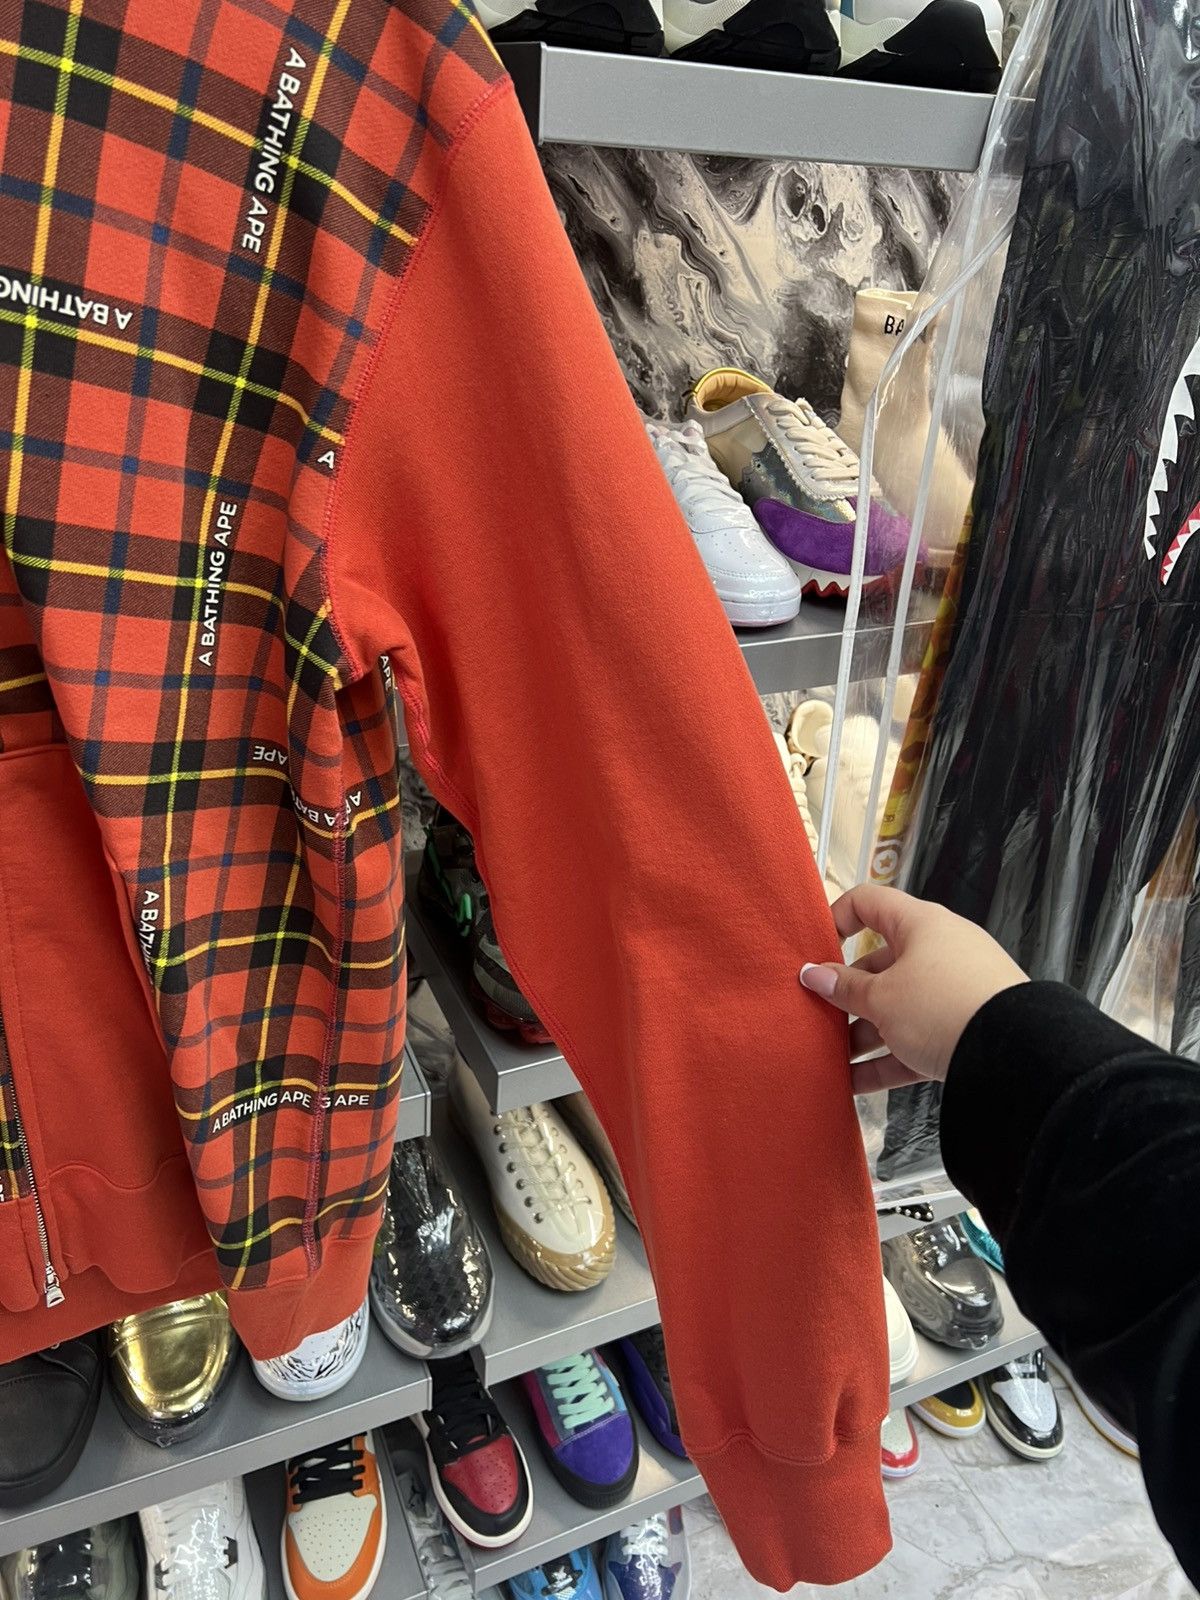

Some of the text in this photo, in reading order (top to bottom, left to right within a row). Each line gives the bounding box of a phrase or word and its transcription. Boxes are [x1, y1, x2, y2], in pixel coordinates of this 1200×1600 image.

[241, 47, 307, 253] A BATHING APE
[114, 307, 133, 330] A
[317, 450, 335, 469] A
[198, 501, 238, 667] A BATHING APE
[252, 745, 288, 765] APE
[143, 889, 160, 905] A
[335, 1094, 370, 1107] APE
[212, 1091, 312, 1133] A BATHING APE
